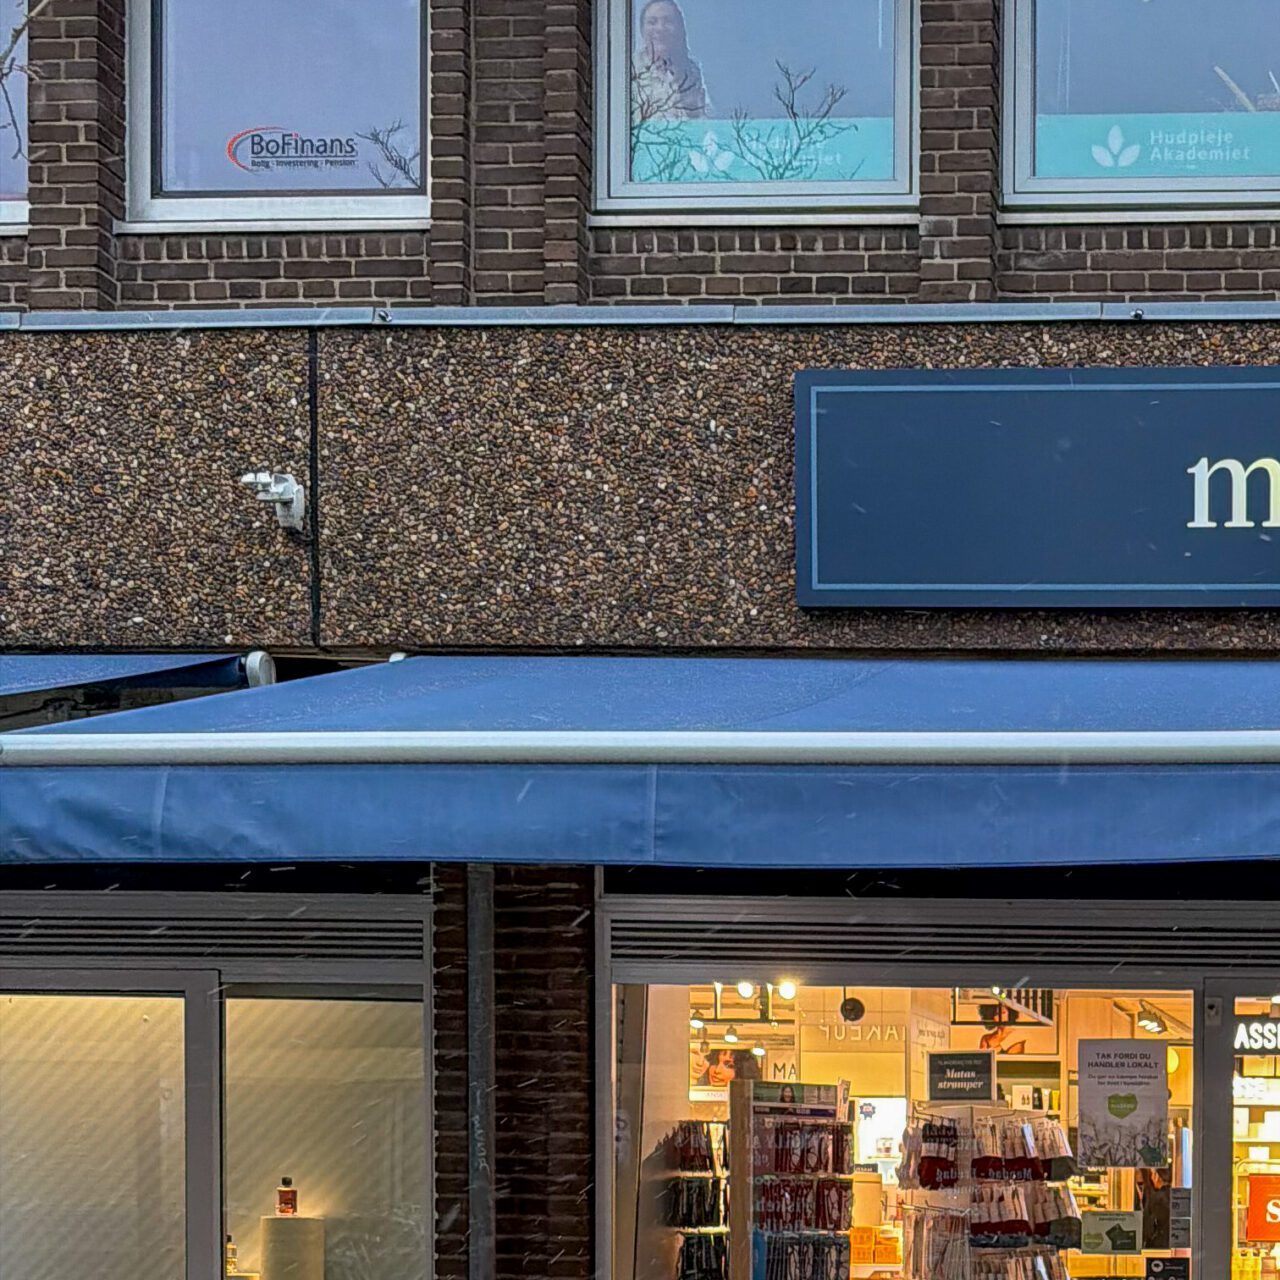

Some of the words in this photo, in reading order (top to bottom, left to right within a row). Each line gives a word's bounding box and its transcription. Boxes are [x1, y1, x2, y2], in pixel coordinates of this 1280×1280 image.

[250, 132, 355, 155] BoFinans
[1150, 129, 1233, 146] Hudpleje
[1150, 147, 1250, 161] Akademiet
[1087, 1061, 1125, 1069] HANDLER
[1127, 1061, 1159, 1069] LOKALT
